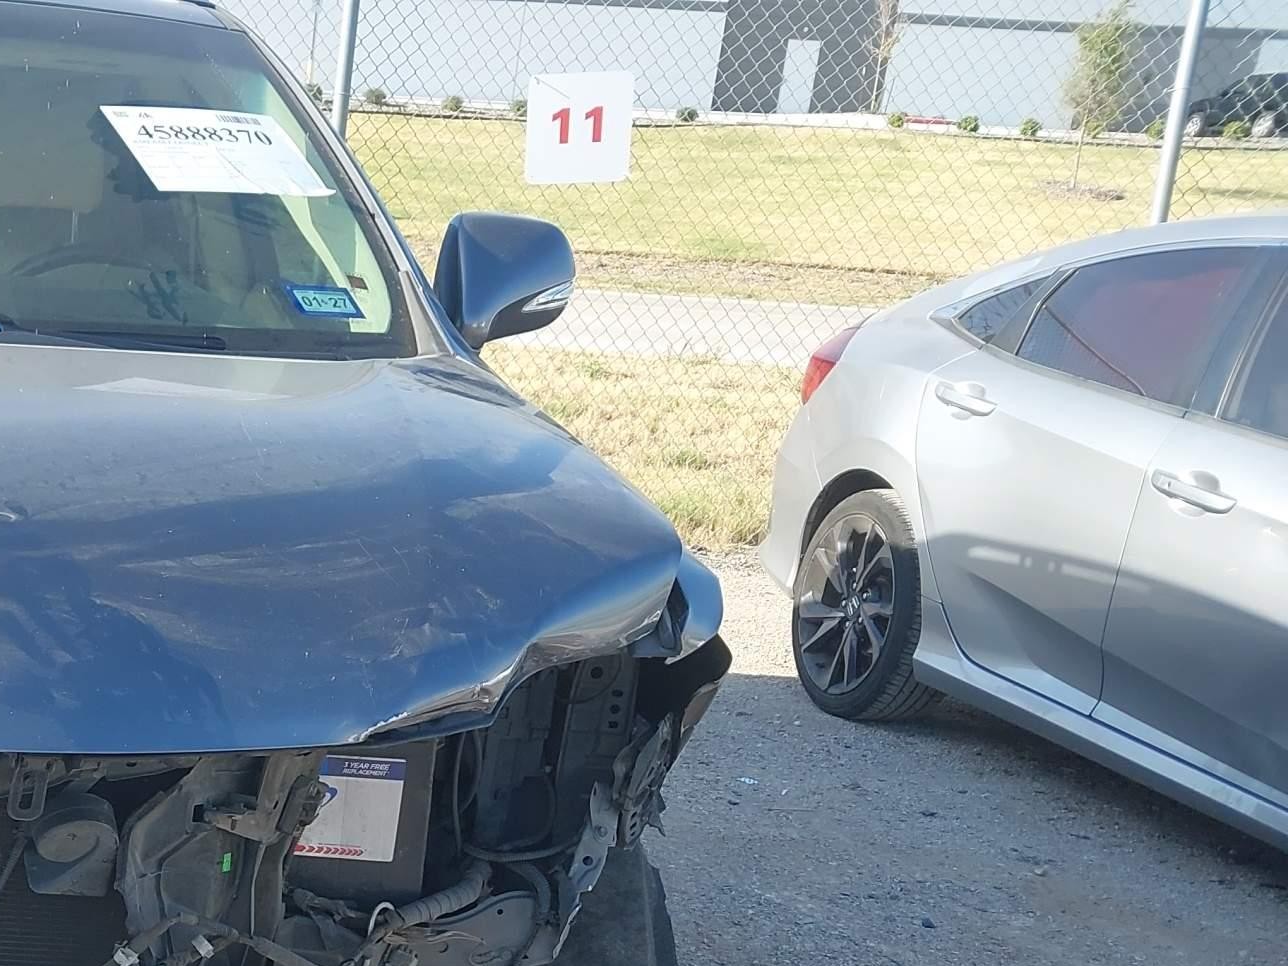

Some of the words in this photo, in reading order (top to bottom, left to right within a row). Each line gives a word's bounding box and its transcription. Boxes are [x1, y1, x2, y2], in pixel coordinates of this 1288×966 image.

[137, 124, 273, 146] 45888370
[551, 105, 604, 144] 11
[349, 762, 370, 770] YEAR
[369, 763, 391, 771] FREE
